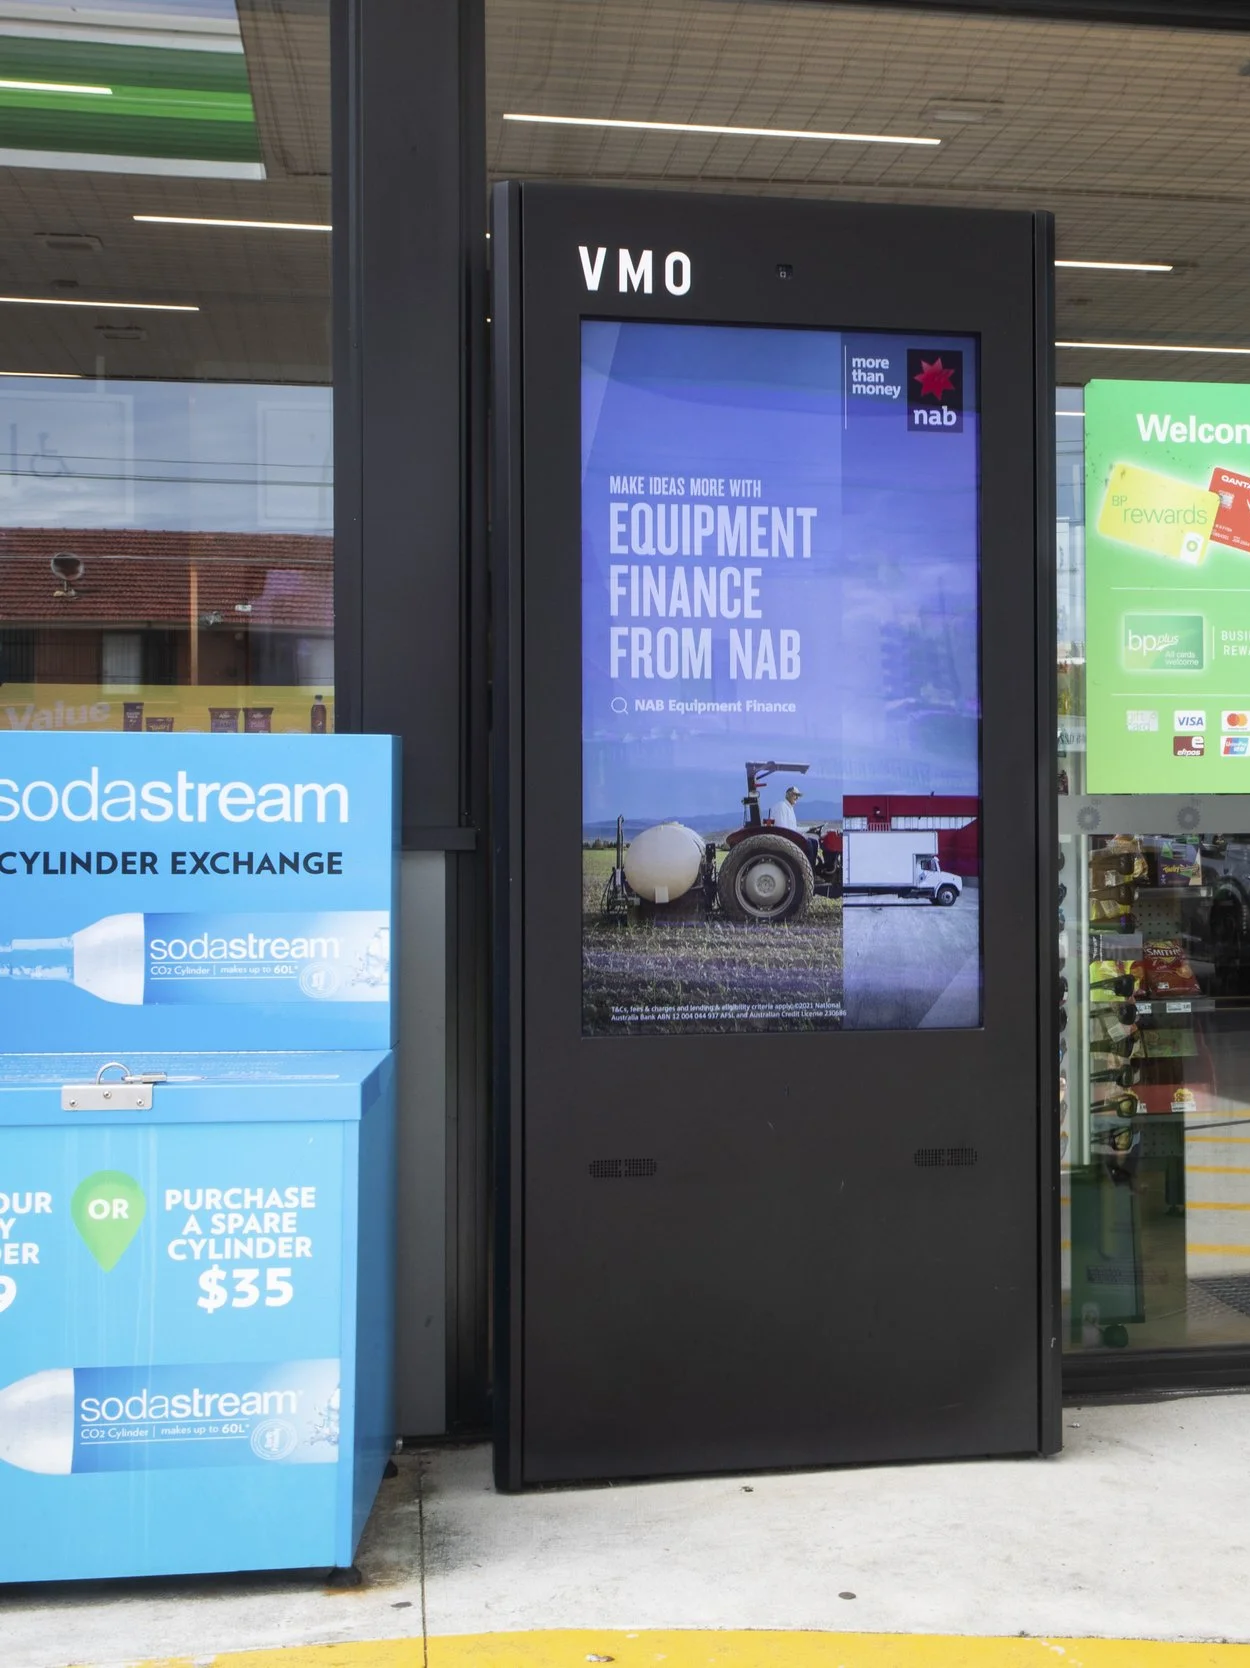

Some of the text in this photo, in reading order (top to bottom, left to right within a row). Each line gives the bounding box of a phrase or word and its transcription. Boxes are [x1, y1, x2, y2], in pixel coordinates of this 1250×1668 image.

[578, 246, 692, 296] VMO
[851, 356, 890, 369] more
[851, 369, 885, 383] than
[851, 383, 901, 399] money
[913, 405, 957, 427] nab
[609, 475, 762, 499] MAKE IDEAS MORE WITH
[1112, 495, 1128, 507] BP
[1123, 503, 1208, 525] rewards
[609, 502, 818, 558] EQUIPMENT
[609, 564, 763, 618] FINANCE
[609, 627, 801, 681] FROM NAB
[1128, 629, 1180, 656] bp plus
[5, 702, 110, 731] Value
[634, 698, 796, 715] NAB Equipment Finance
[1178, 716, 1204, 726] VISA
[0, 766, 350, 824] sodastream
[0, 850, 343, 876] CYLINDER EXCHANGE
[150, 932, 341, 961] sodastream
[151, 967, 172, 976] CO2
[174, 966, 210, 977] Cylinder
[220, 964, 247, 974] makes
[249, 966, 261, 976] up
[262, 966, 271, 974] to
[651, 1005, 675, 1013] charges
[88, 1198, 130, 1220] OR
[165, 1187, 316, 1212] PURCHASE
[181, 1212, 298, 1236] A SPARE
[0, 1243, 40, 1265] ER
[167, 1236, 313, 1261] CYLINDER
[197, 1264, 294, 1314] $35
[80, 1389, 298, 1422] sodastream
[81, 1429, 105, 1440] CO2
[108, 1428, 148, 1440] Cylinder
[161, 1425, 191, 1435] makes
[193, 1427, 205, 1436] up
[208, 1426, 218, 1434] to
